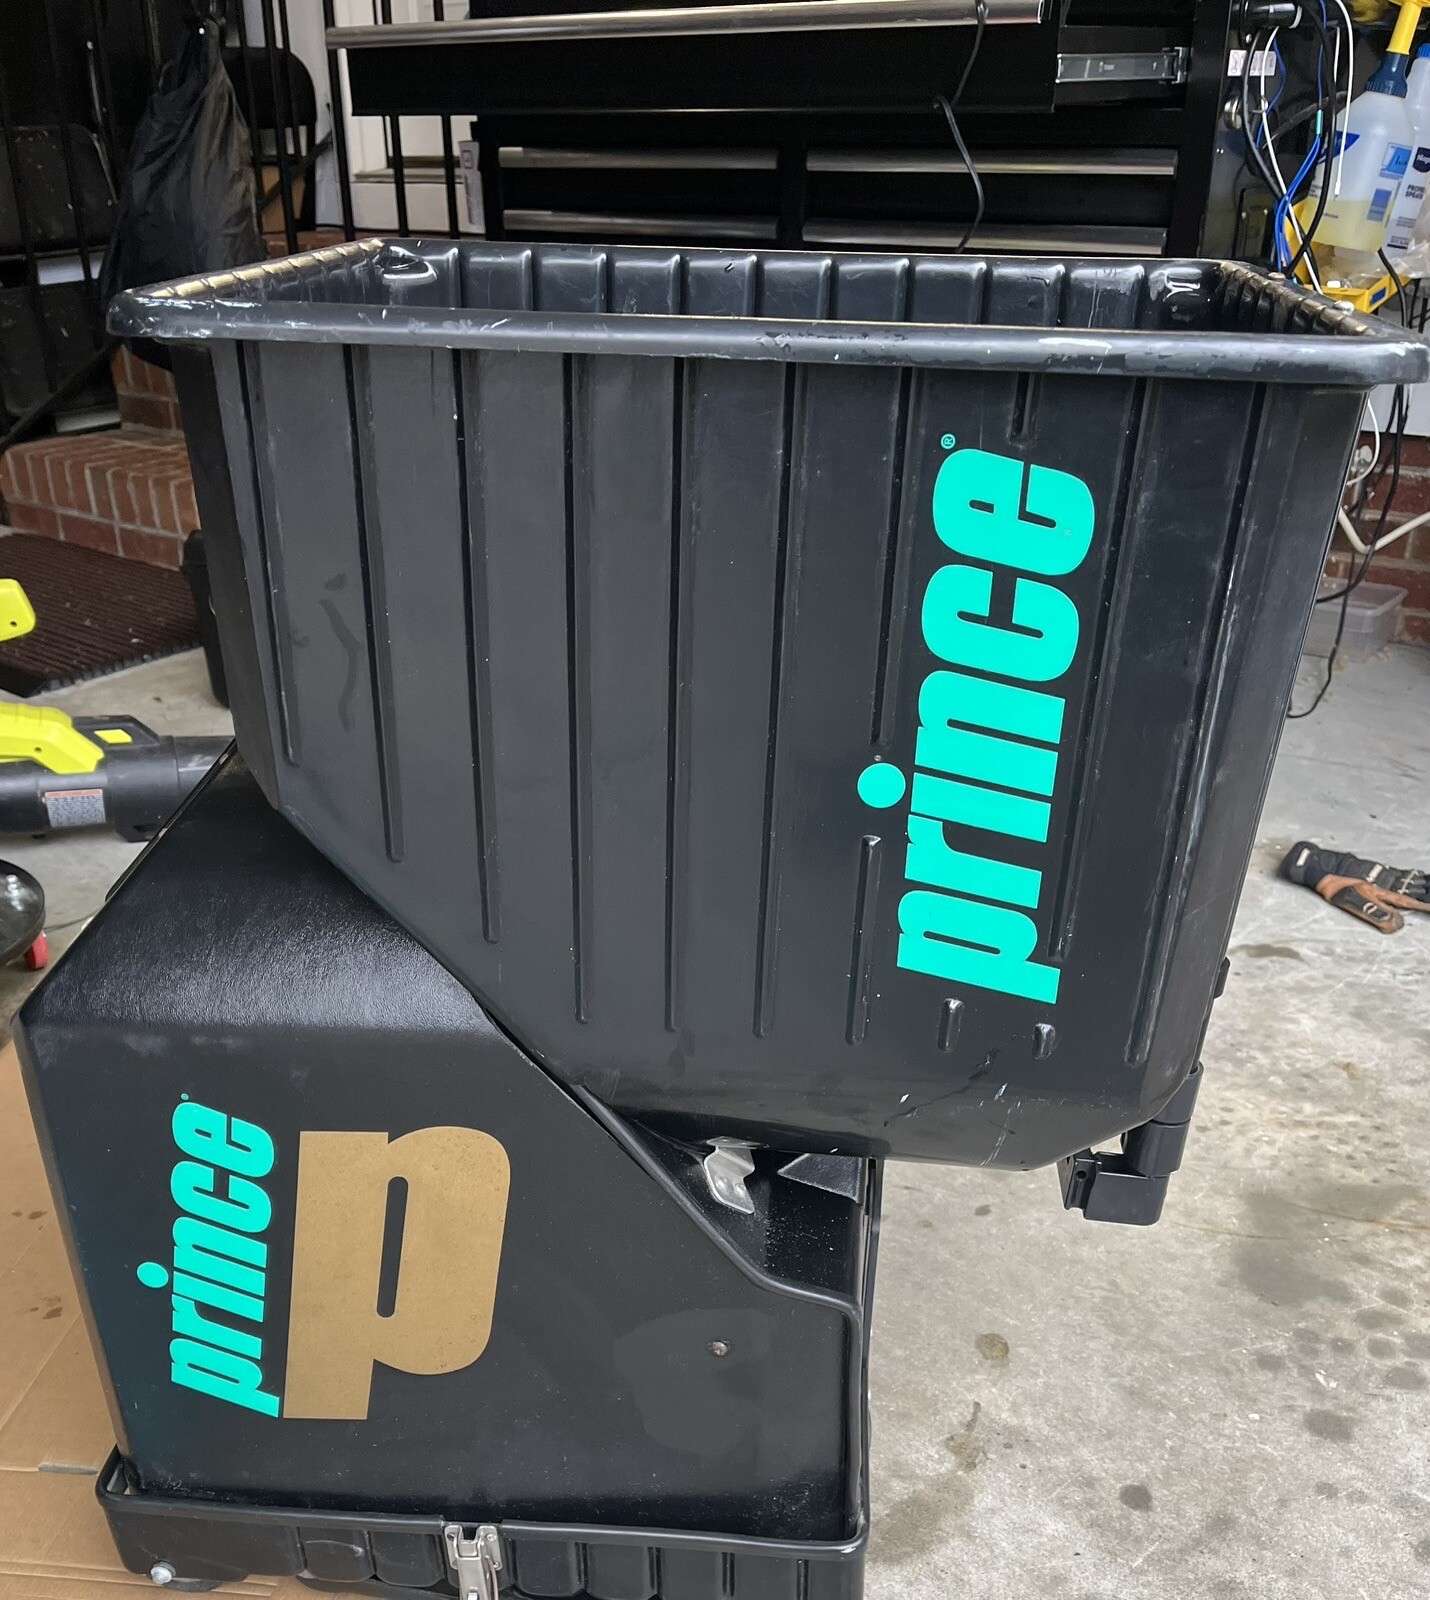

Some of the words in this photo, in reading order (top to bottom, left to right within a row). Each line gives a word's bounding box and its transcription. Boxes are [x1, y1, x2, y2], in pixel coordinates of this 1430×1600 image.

[856, 447, 1096, 1005] prince
[136, 1101, 281, 1419] prince
[282, 1125, 511, 1420] p
